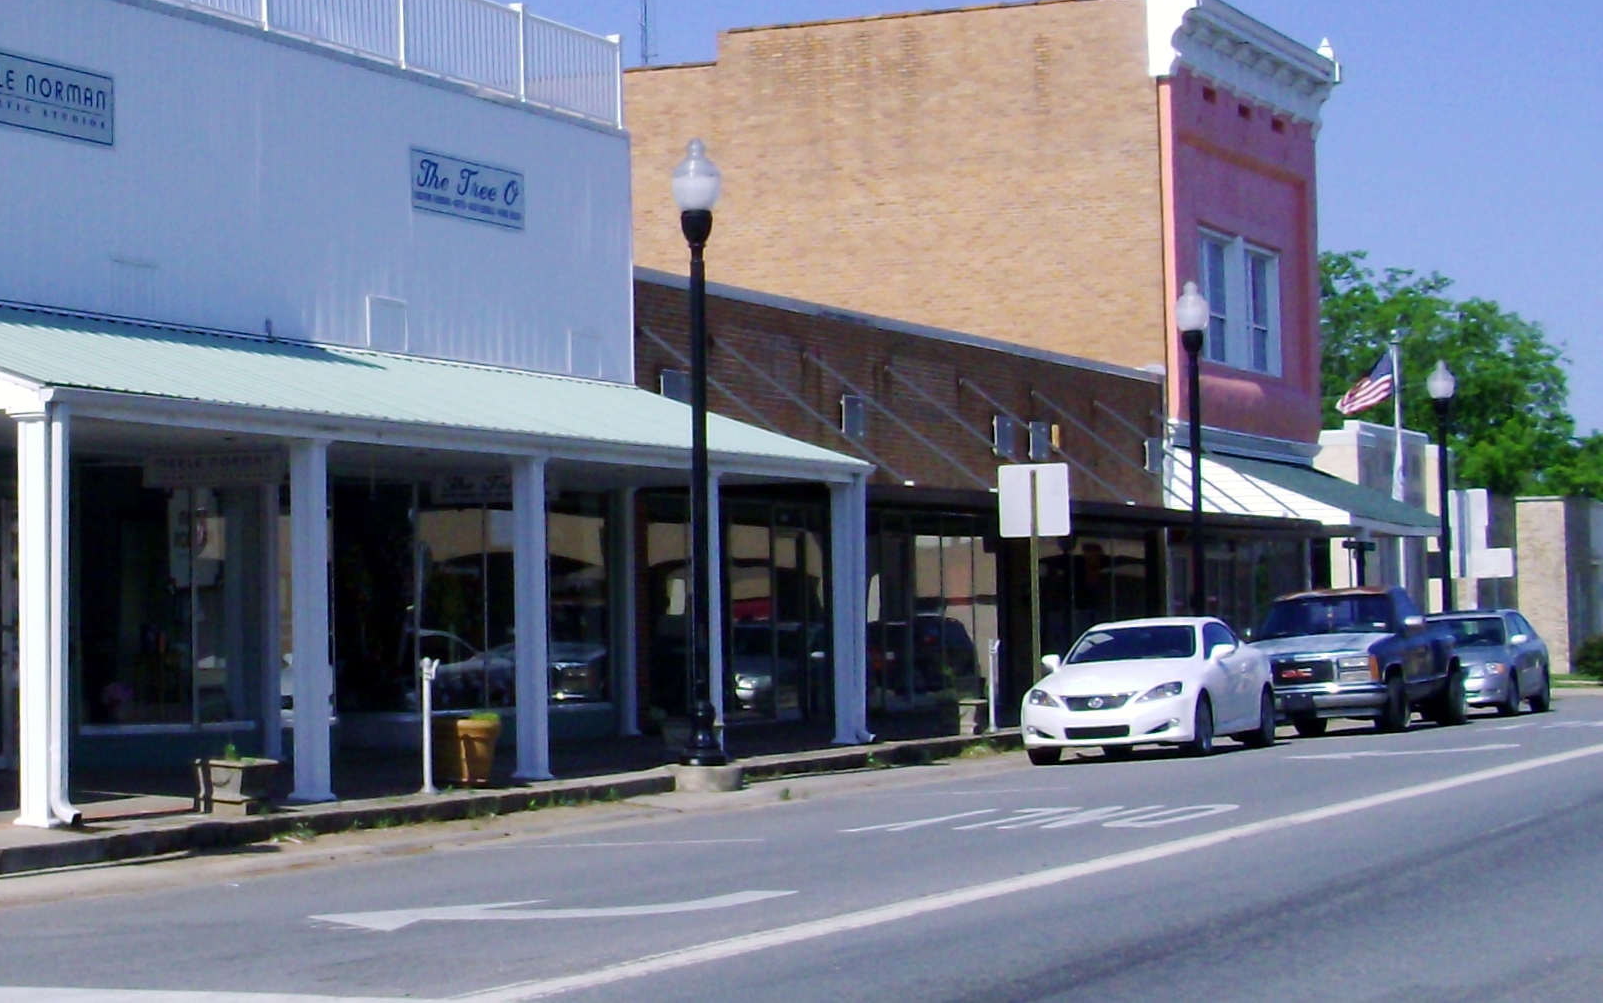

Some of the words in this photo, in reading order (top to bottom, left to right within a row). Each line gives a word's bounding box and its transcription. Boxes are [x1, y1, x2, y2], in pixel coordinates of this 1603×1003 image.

[26, 74, 106, 110] NORMAN
[43, 109, 105, 130] STUDIOS
[417, 159, 449, 191] The
[457, 168, 497, 201] Tree
